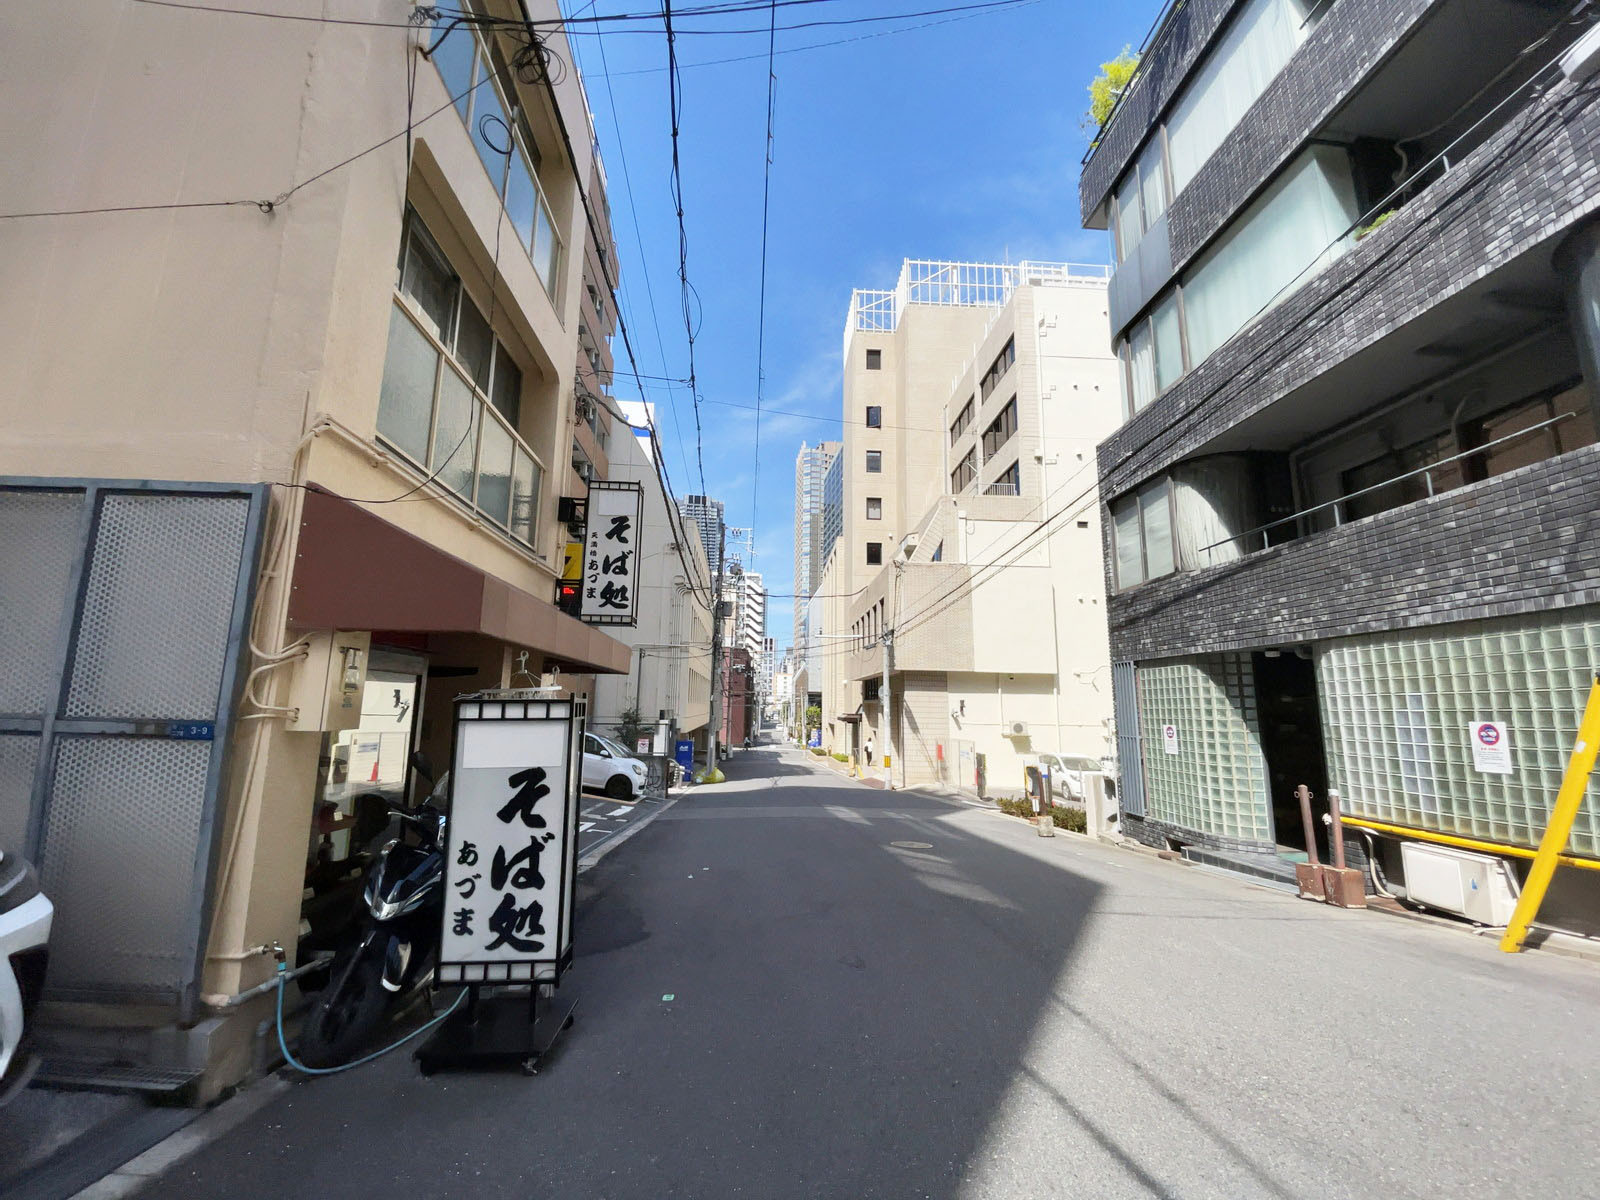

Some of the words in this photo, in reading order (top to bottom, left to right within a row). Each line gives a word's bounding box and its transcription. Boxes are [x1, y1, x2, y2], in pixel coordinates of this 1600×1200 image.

[599, 516, 634, 609] そば処
[190, 726, 208, 735] 3-9
[452, 841, 482, 937] あづま
[485, 767, 556, 953] そば処
